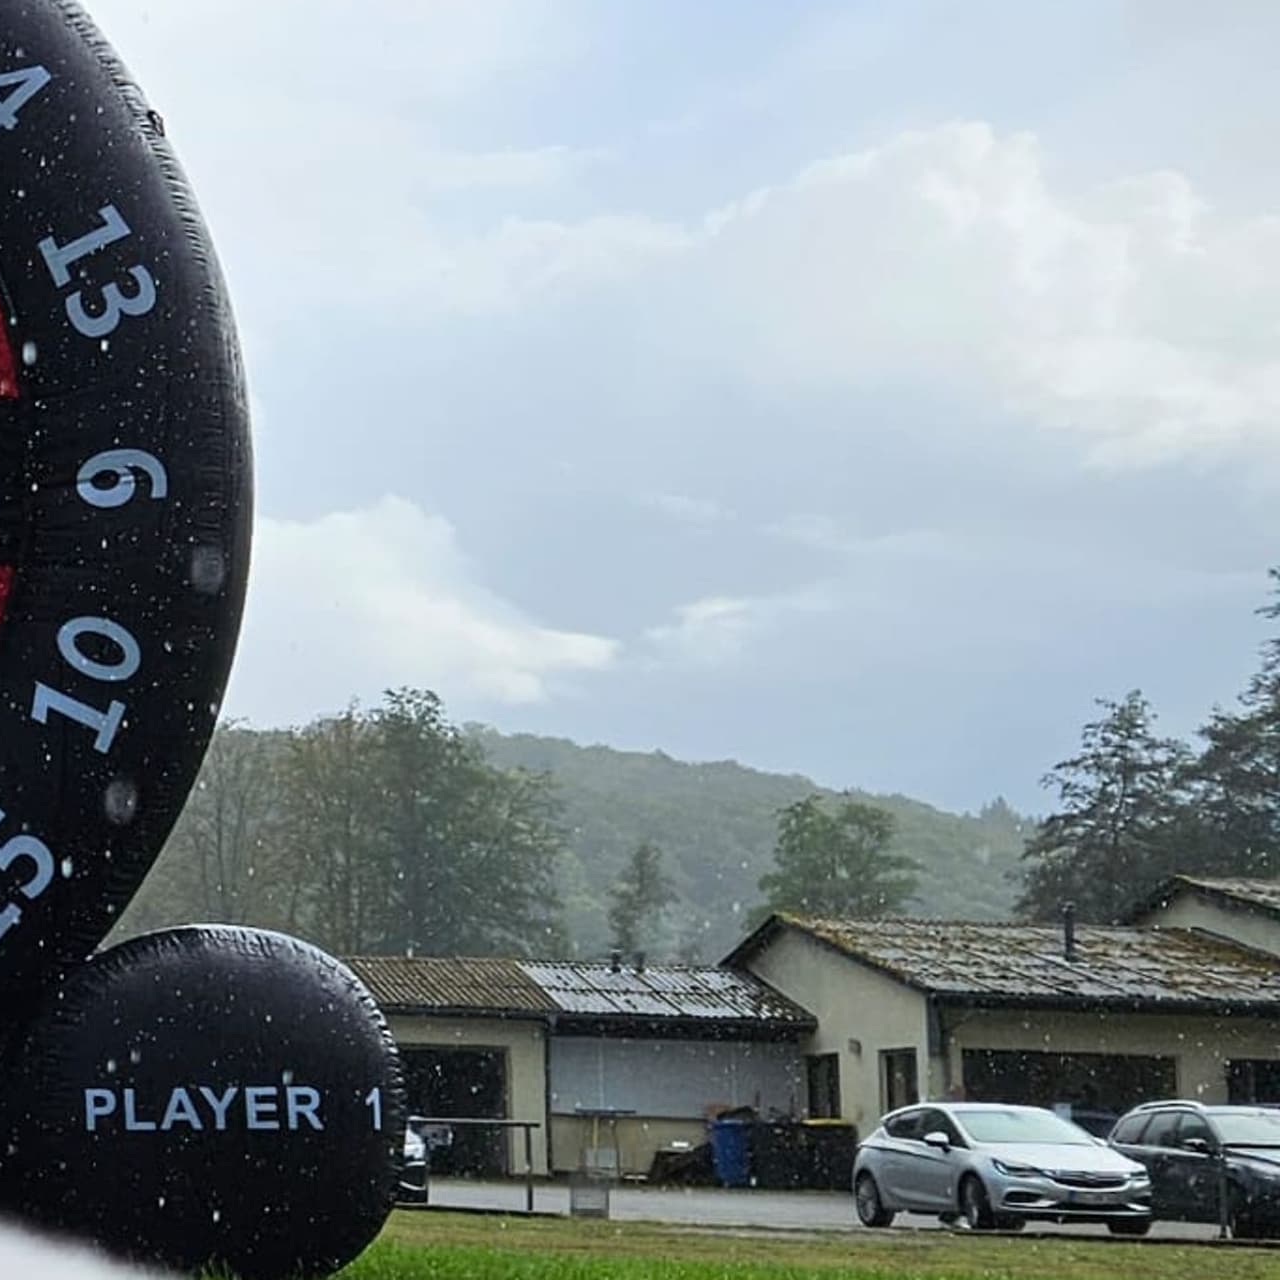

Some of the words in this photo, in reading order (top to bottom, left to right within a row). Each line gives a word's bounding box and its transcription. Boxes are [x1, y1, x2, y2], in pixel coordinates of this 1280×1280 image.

[39, 205, 157, 337] 13
[77, 449, 167, 507] 6
[31, 617, 140, 753] 10
[85, 1086, 323, 1130] PLAYER
[366, 1087, 381, 1129] 1
